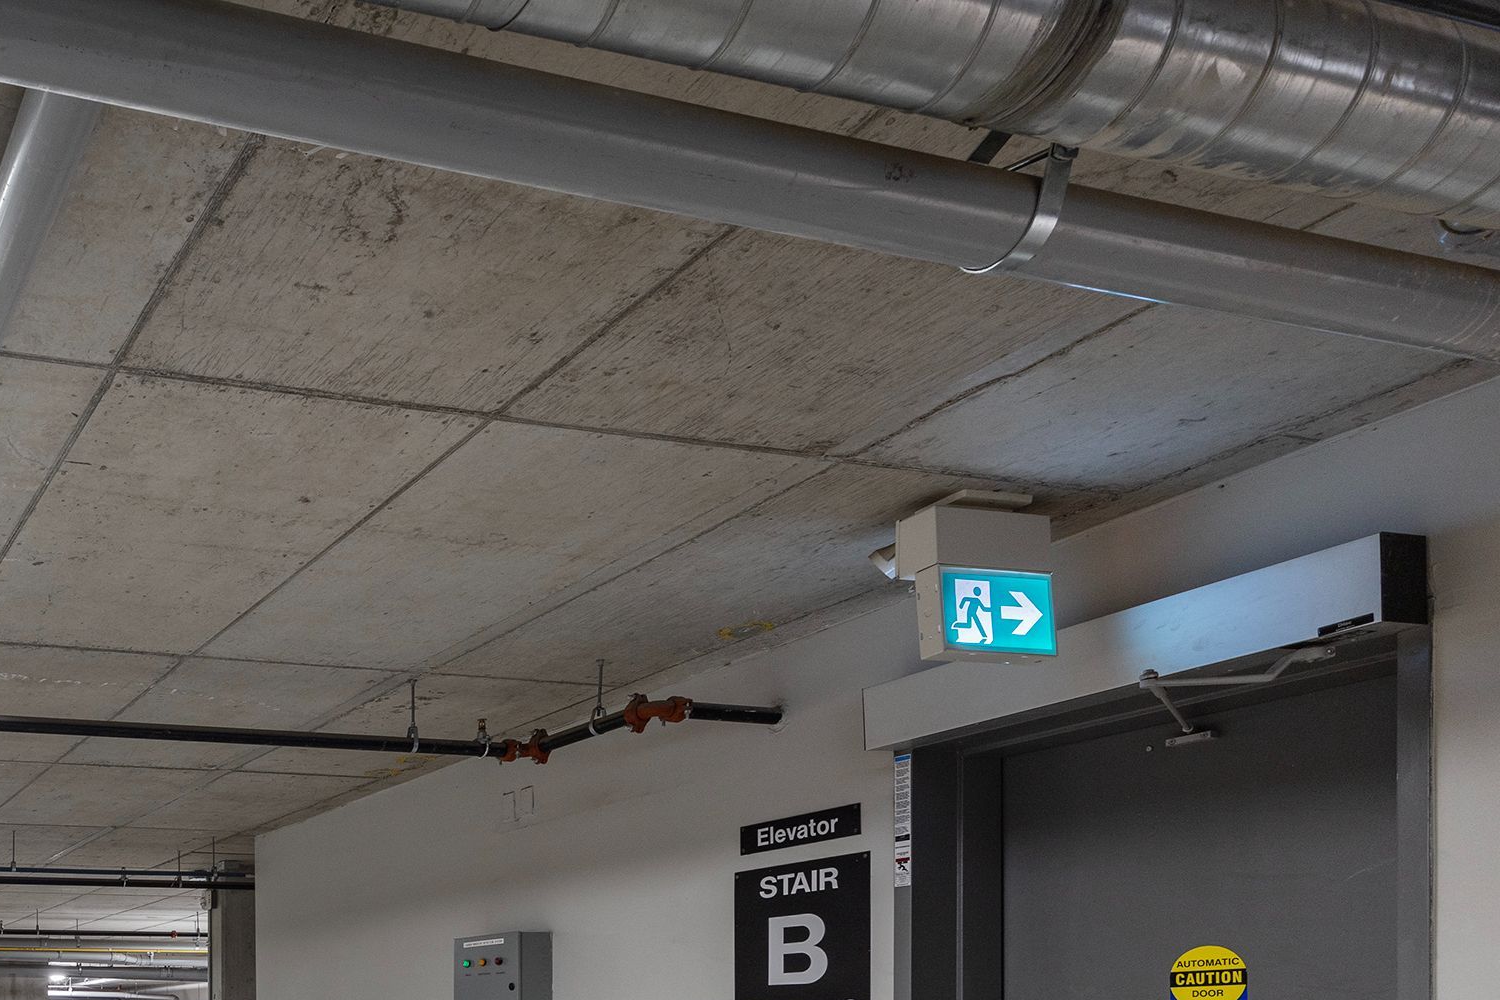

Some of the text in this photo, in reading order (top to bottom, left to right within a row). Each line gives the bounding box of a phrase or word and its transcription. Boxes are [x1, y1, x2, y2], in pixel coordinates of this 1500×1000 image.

[757, 817, 839, 847] Elevator
[759, 867, 839, 899] STAIR
[768, 913, 829, 986] B
[1176, 957, 1240, 968] AUTOMATIC
[1175, 970, 1243, 986] CAUTION
[1192, 989, 1224, 998] DOOR
